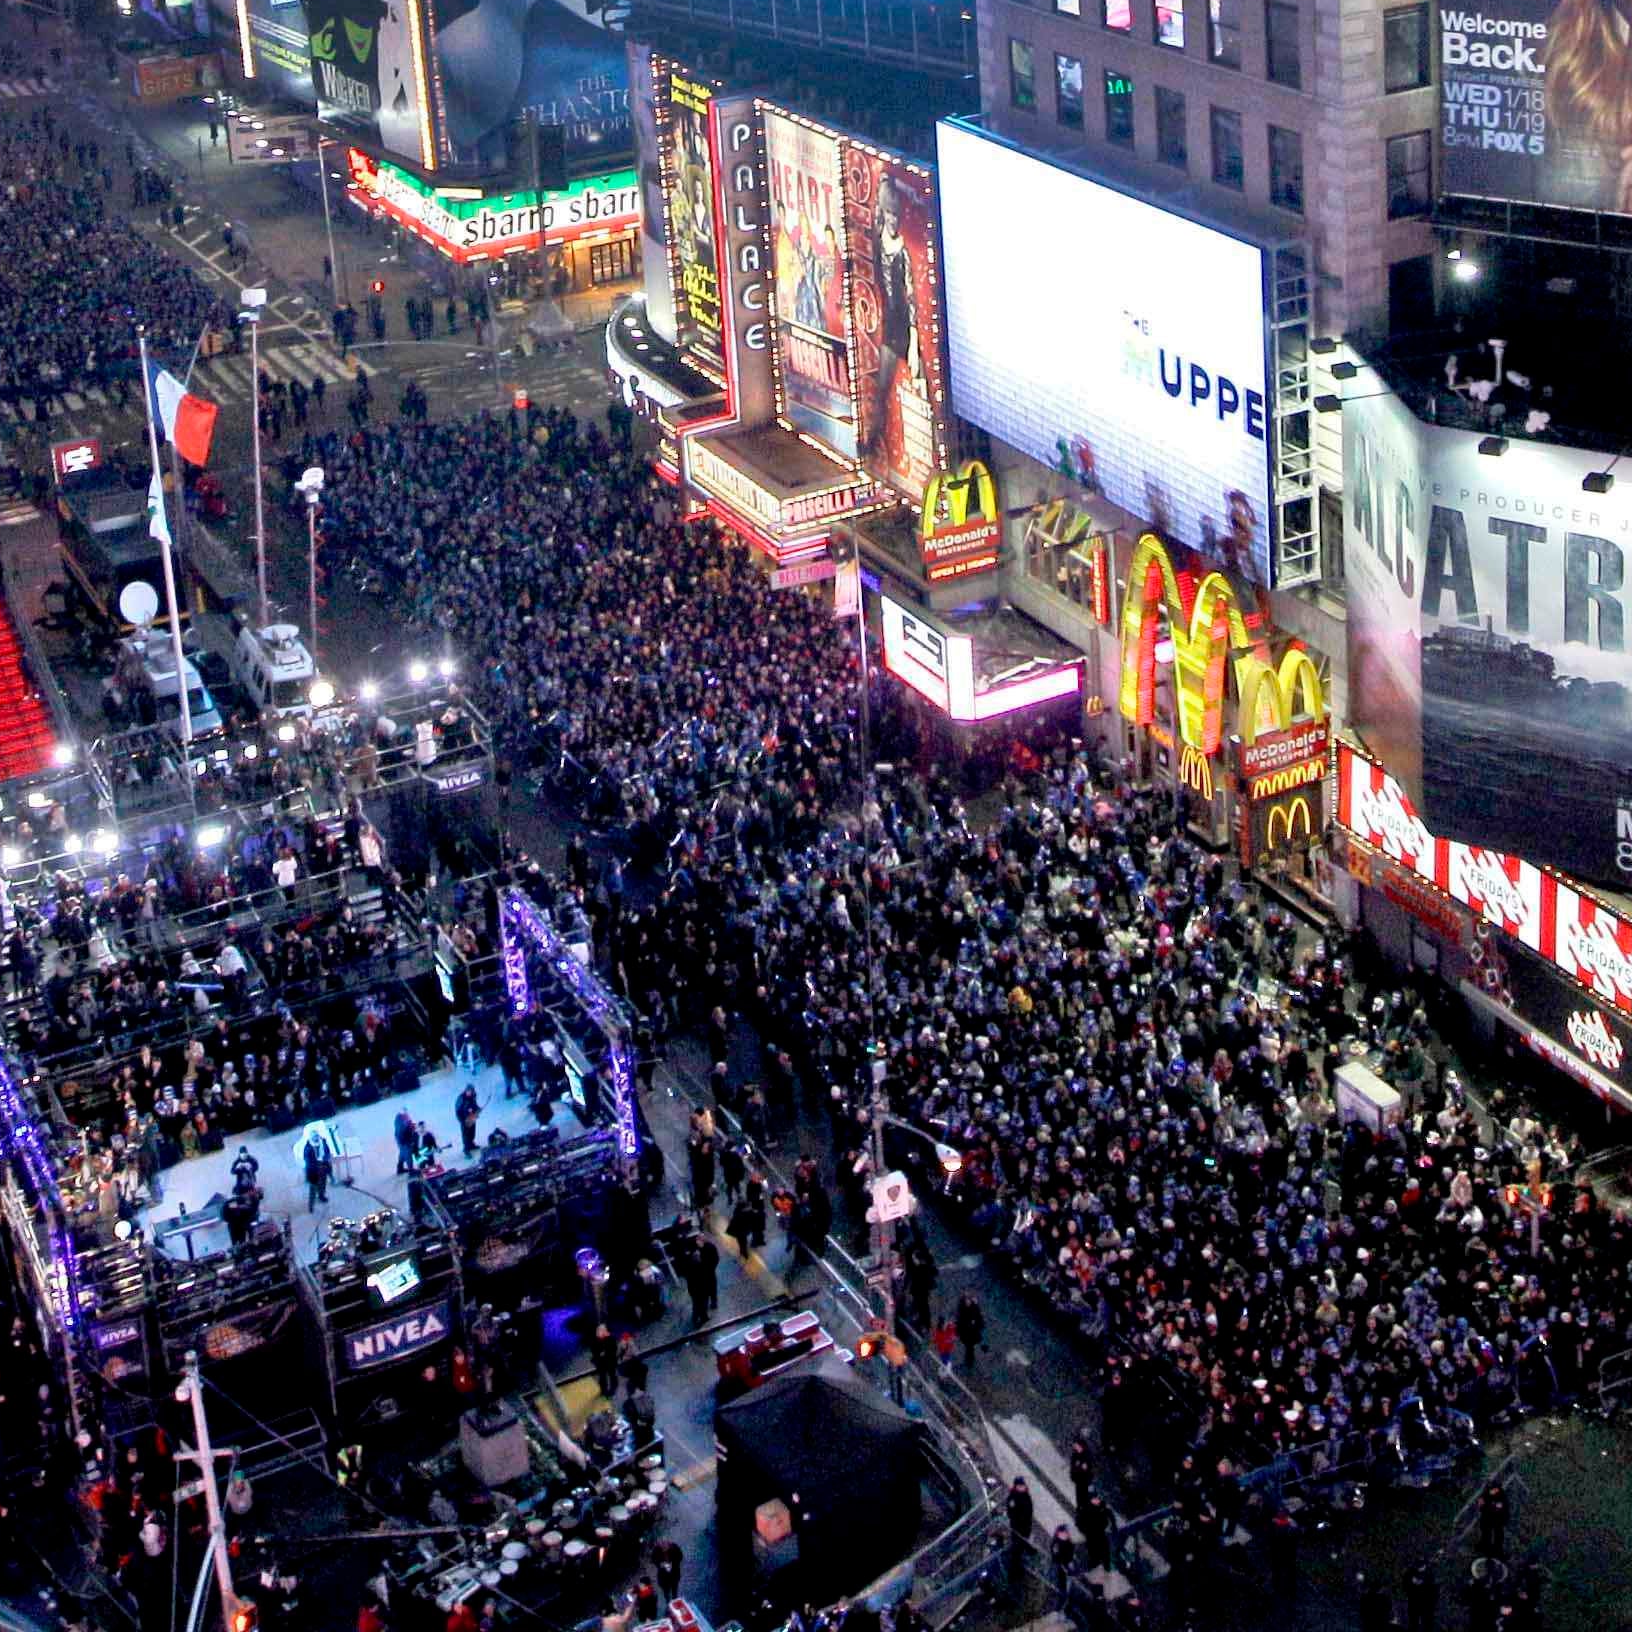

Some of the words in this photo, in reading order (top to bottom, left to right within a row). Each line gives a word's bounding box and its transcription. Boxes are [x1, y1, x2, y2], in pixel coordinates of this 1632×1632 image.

[1440, 9, 1547, 39] Welcome
[1443, 31, 1546, 73] Back.
[1443, 80, 1502, 107] WED
[1504, 87, 1546, 112] 1/18
[1443, 103, 1500, 128] THU
[1504, 110, 1546, 134] 1/19
[1482, 129, 1526, 153] FOX
[1527, 135, 1546, 156] 5
[569, 188, 639, 224] sbarr
[732, 122, 767, 351] PALACE
[1460, 489, 1602, 528] PRODUCER
[923, 524, 999, 553] McDonald's
[1245, 728, 1326, 765] McDonald's
[353, 1313, 445, 1362] NIVEA
